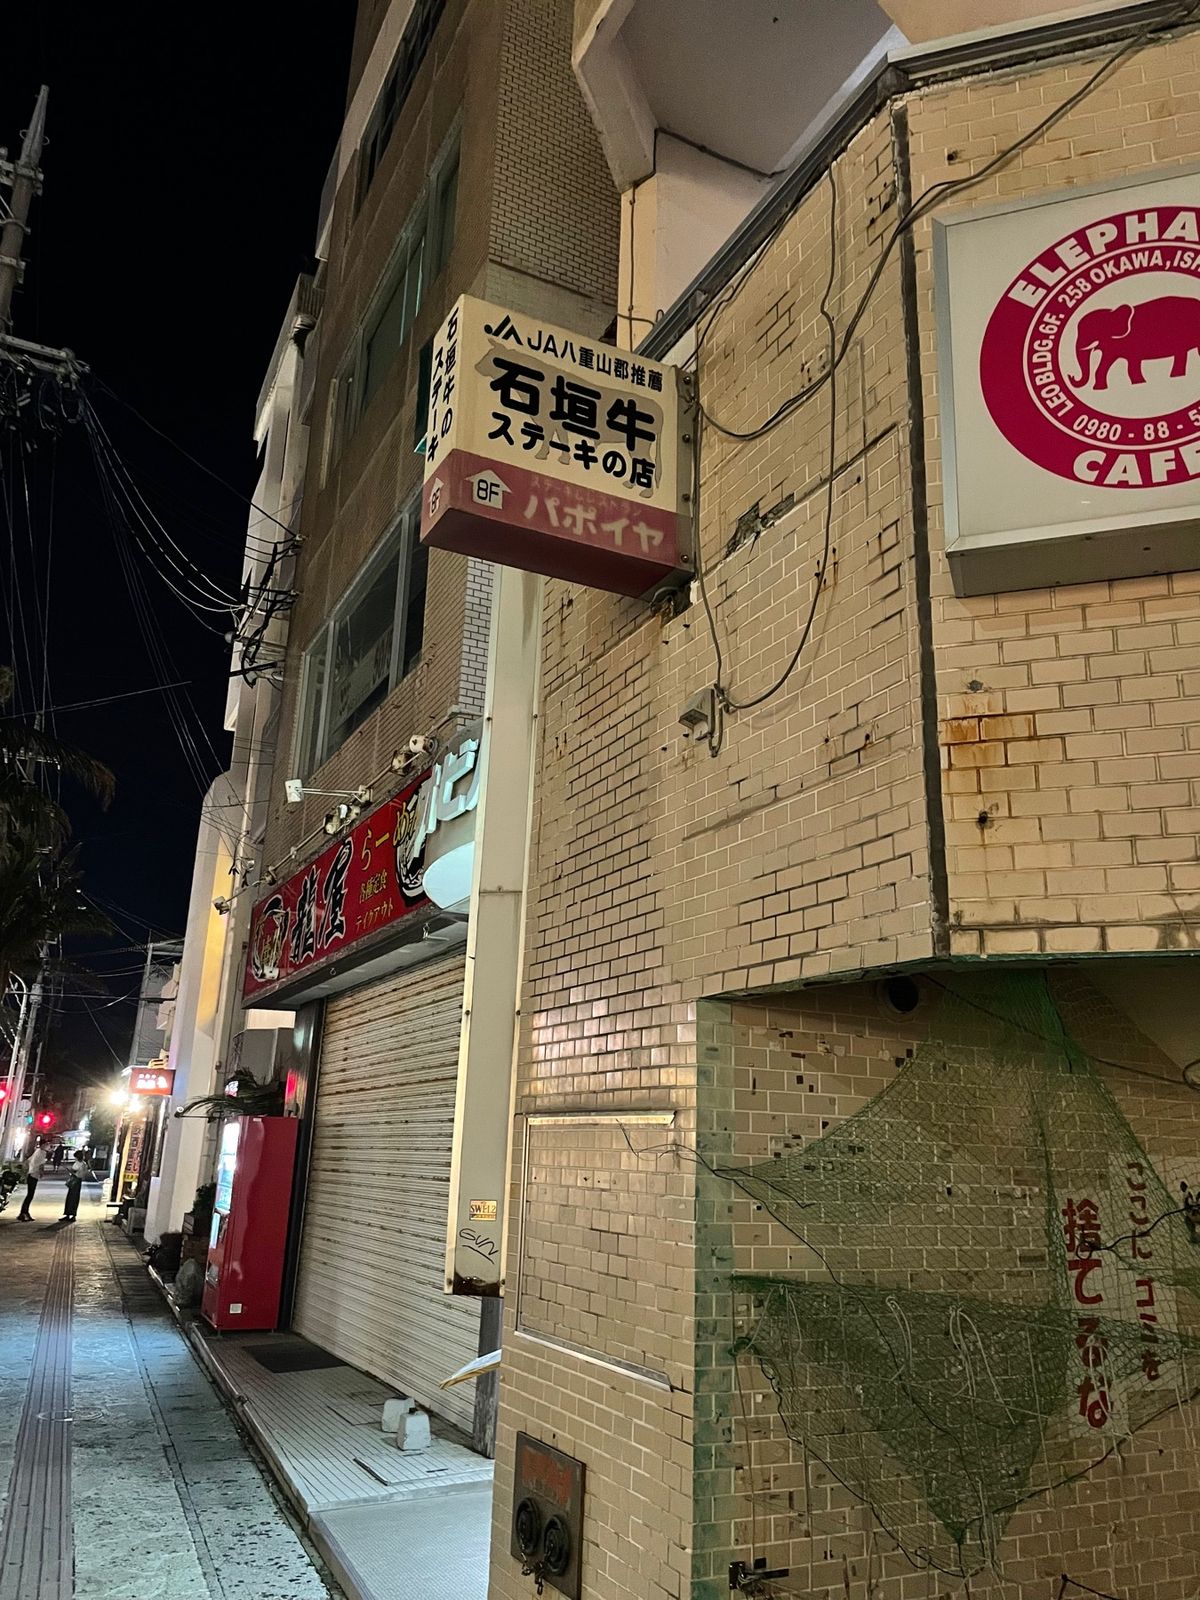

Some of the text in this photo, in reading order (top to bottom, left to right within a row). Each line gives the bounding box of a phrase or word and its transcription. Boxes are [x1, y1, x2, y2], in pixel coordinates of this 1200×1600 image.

[1008, 210, 1200, 308] ELEPHA
[1057, 278, 1092, 308] 258
[441, 307, 459, 439] 石垣牛の
[527, 330, 663, 393] JA八重山郡推薦
[427, 346, 443, 462] ステーキ
[489, 357, 656, 452] 石垣牛
[1072, 414, 1122, 442] 0980
[487, 411, 656, 489] ステーキの店
[476, 478, 501, 503] 8F
[523, 494, 665, 553] パポイヤ
[355, 896, 394, 934] テイクアウト
[1126, 1162, 1153, 1260] ここに
[1061, 1197, 1111, 1429] 捨てるな
